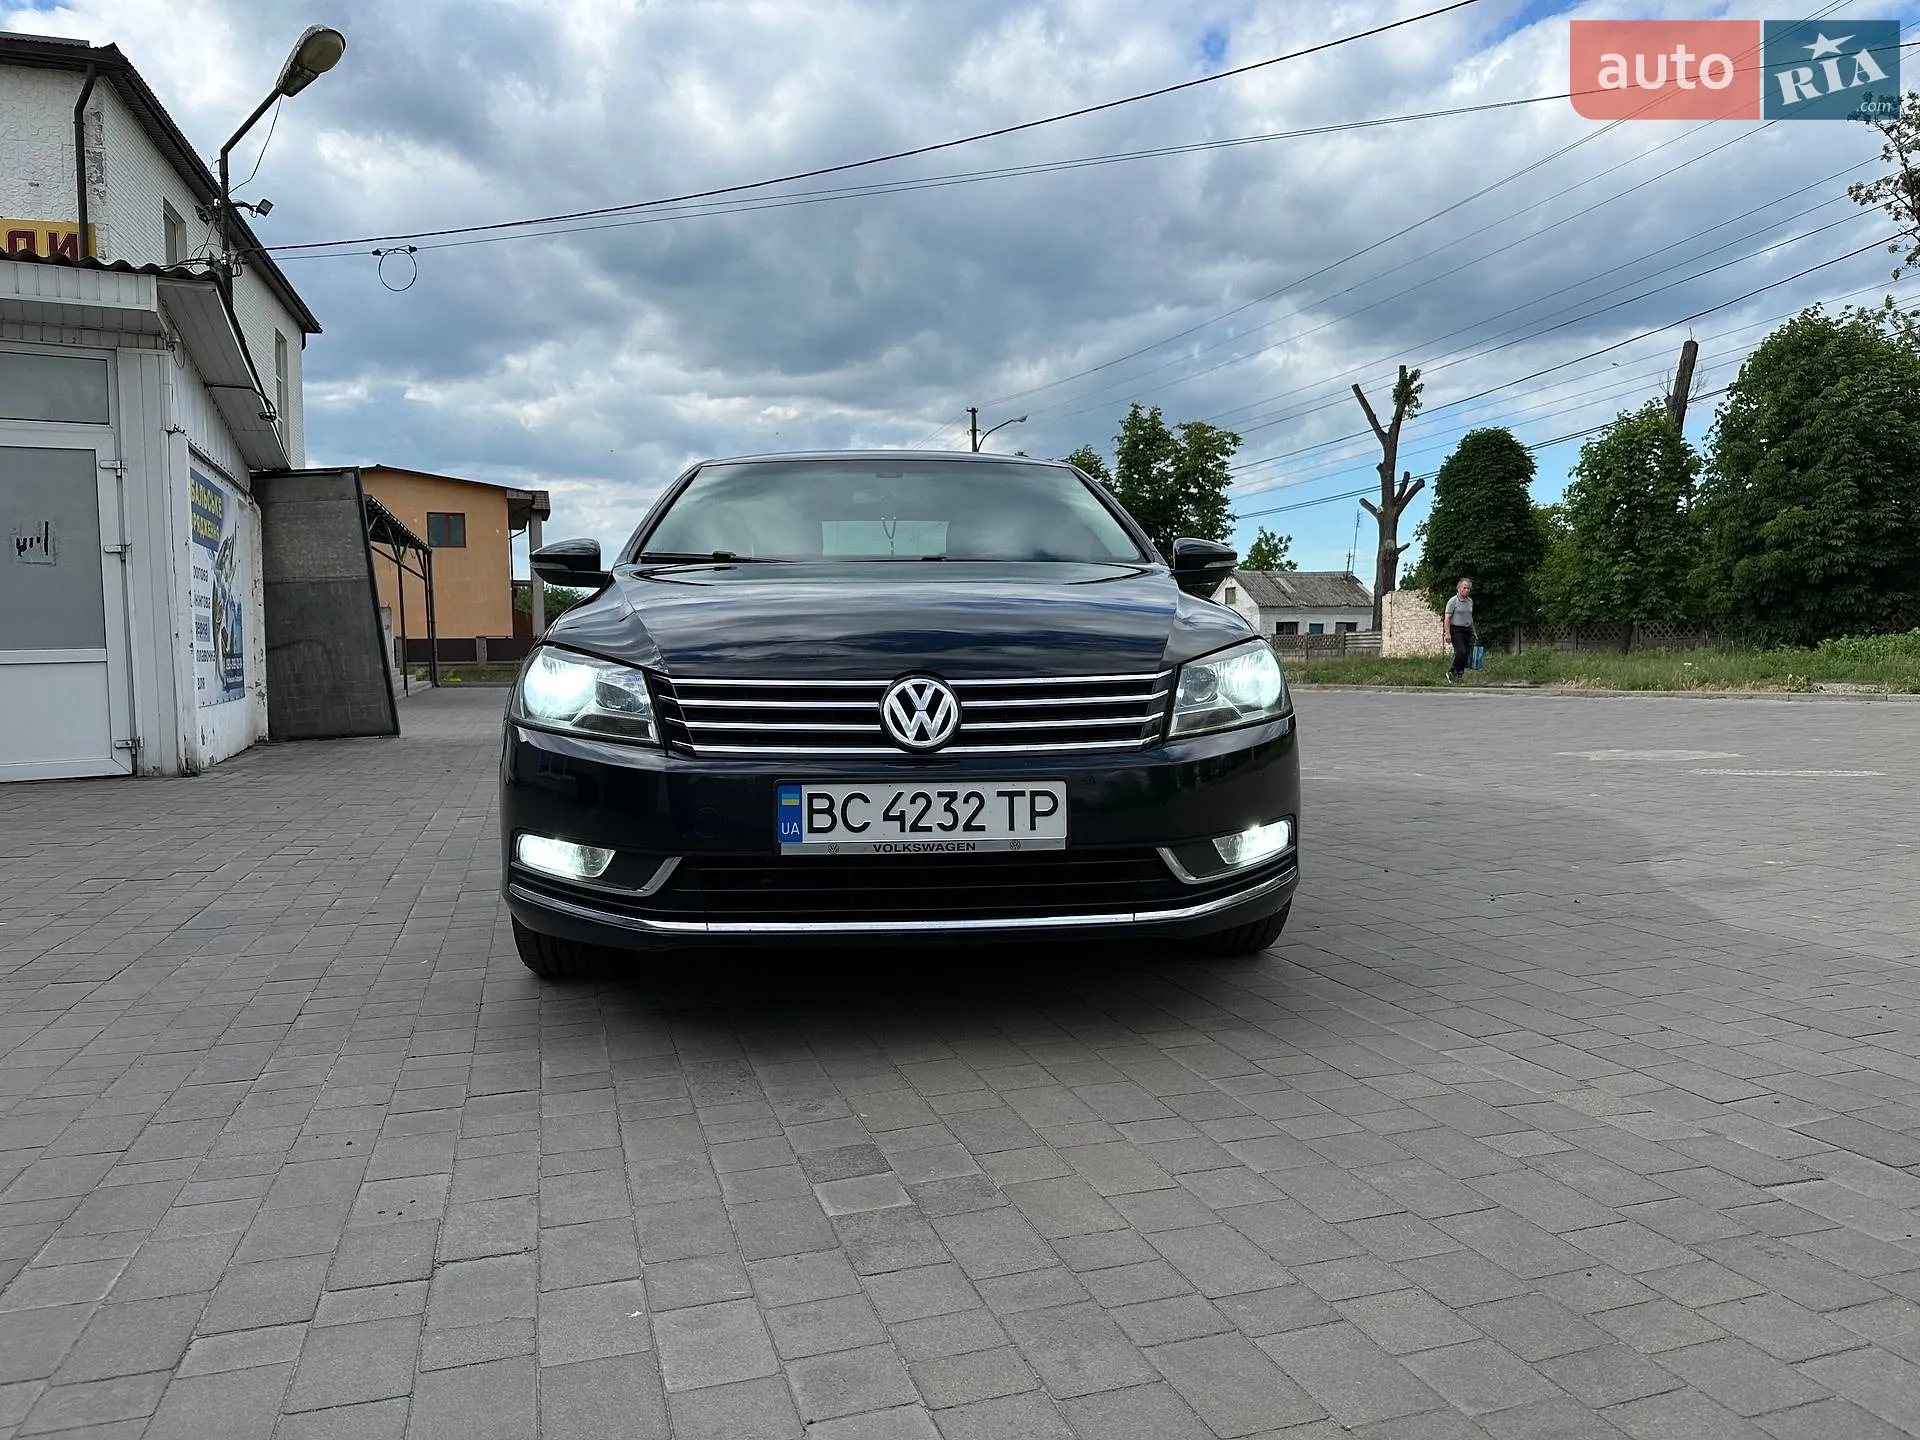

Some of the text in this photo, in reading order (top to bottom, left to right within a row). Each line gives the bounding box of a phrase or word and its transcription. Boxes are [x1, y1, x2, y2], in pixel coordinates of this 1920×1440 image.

[806, 789, 1059, 834] BC 4232 TP
[781, 824, 800, 836] UA
[872, 842, 976, 853] VOLKSWAGEN
